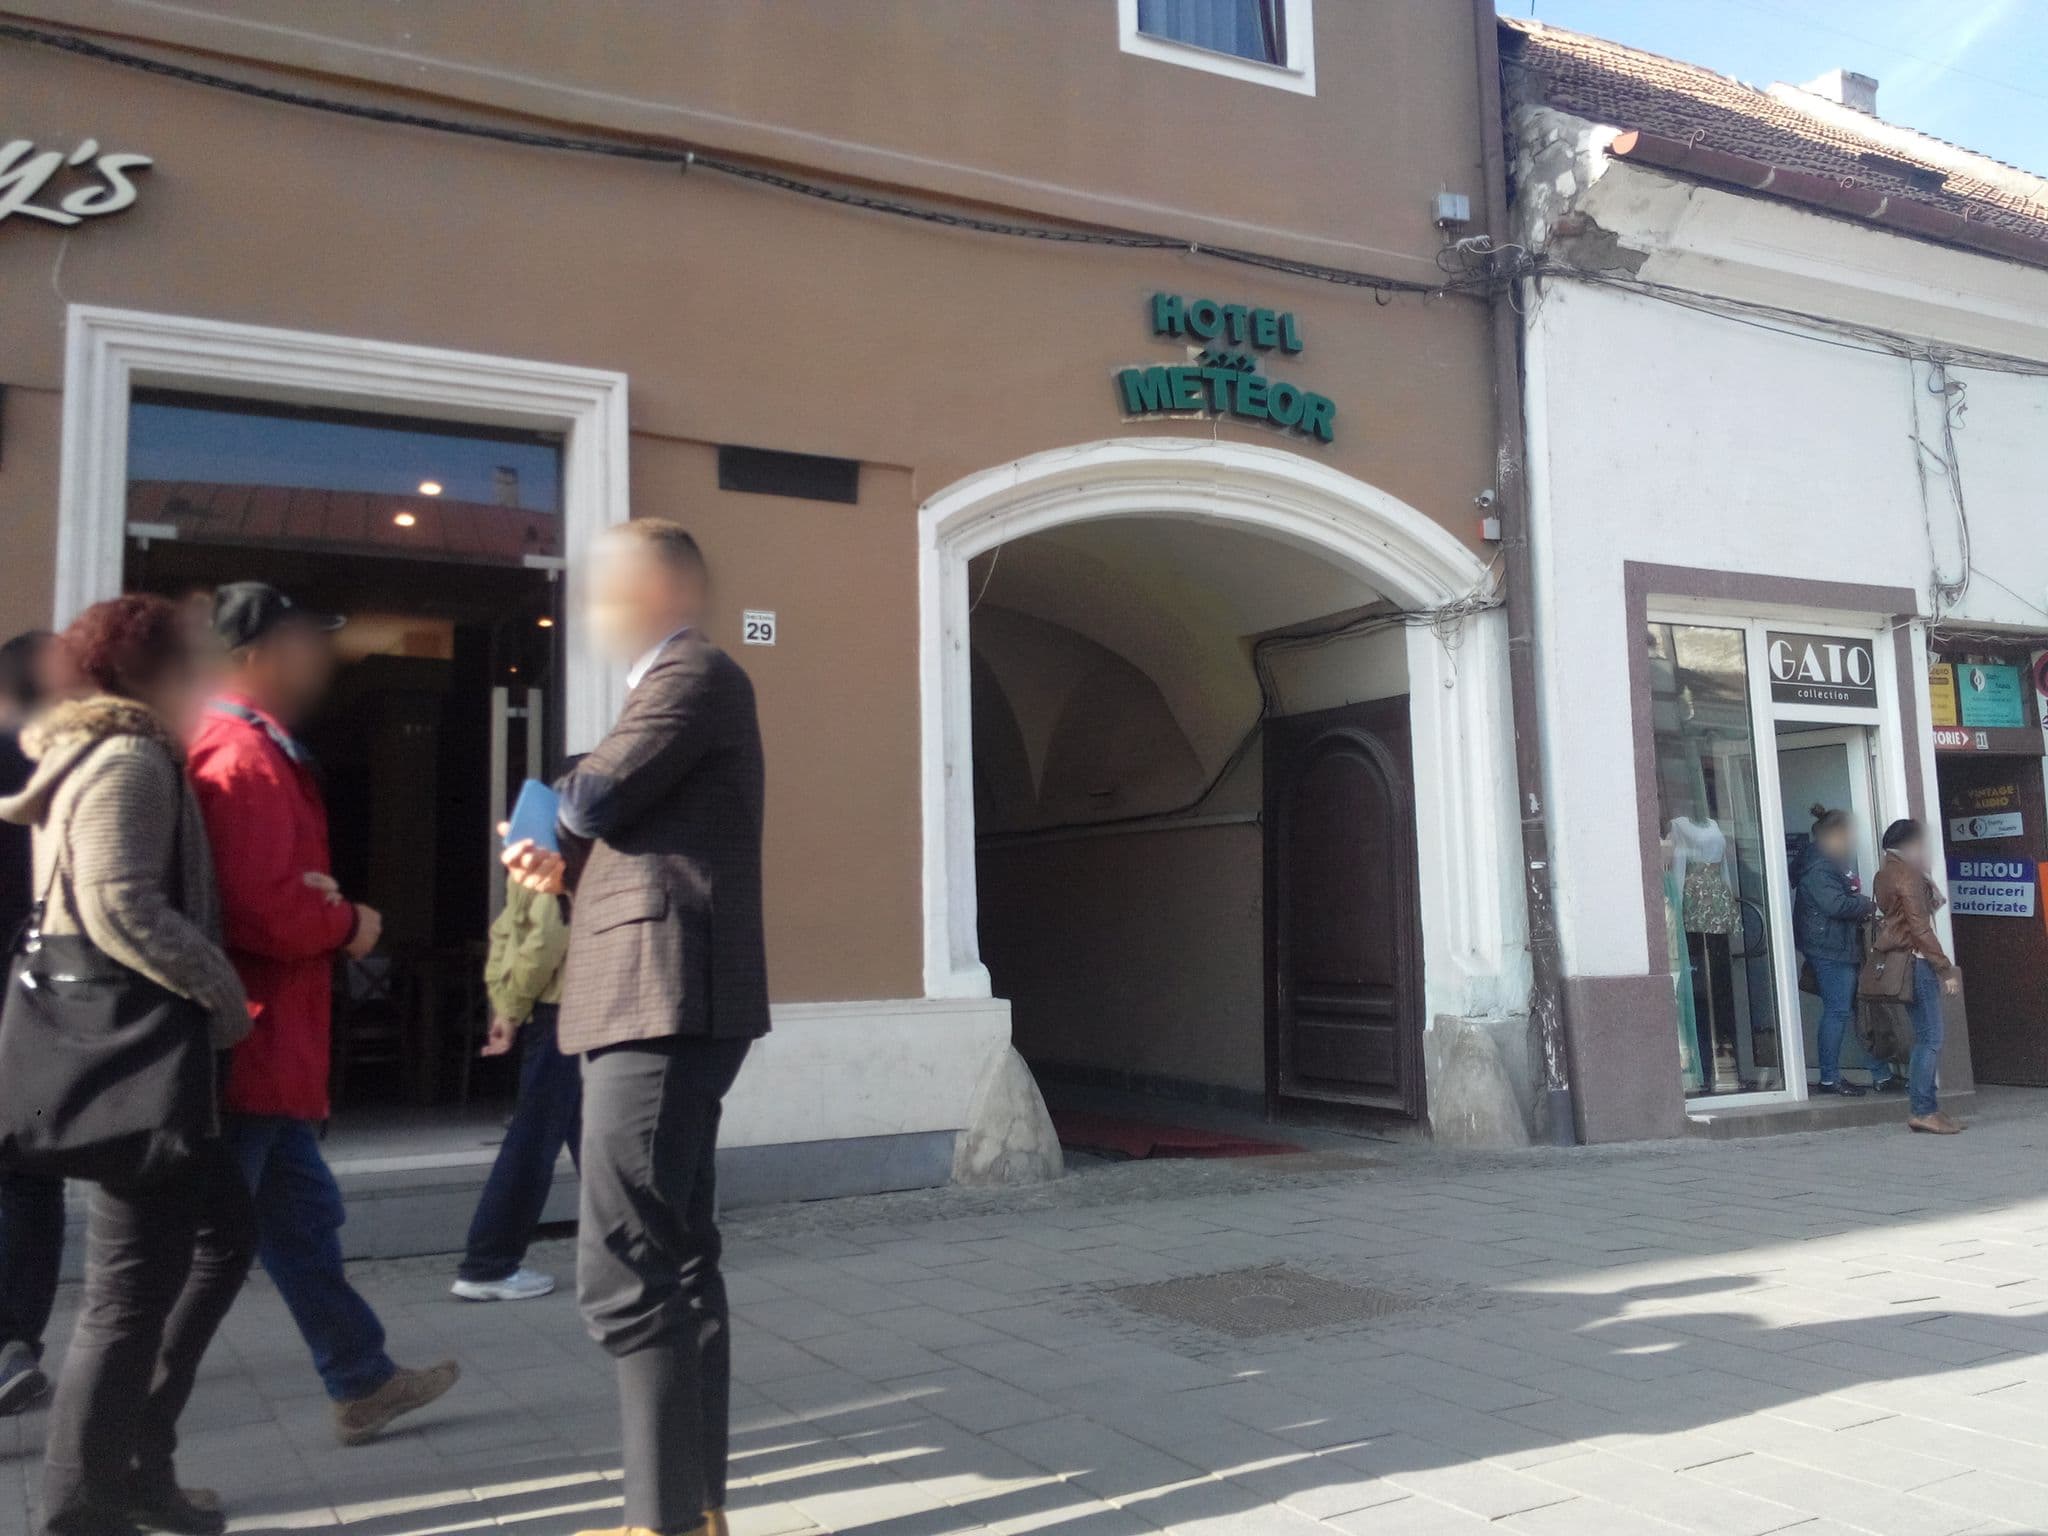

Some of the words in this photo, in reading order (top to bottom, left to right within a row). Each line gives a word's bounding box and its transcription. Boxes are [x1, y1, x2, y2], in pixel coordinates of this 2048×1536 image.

[1153, 292, 1303, 353] HOTEL
[1118, 366, 1336, 443] METEOR
[746, 622, 773, 641] 29
[1769, 639, 1872, 686] GATO
[1797, 689, 1850, 701] collection
[1959, 862, 2023, 878] BIROU
[1957, 885, 2025, 897] traduceri
[1953, 900, 2028, 913] autorizate
